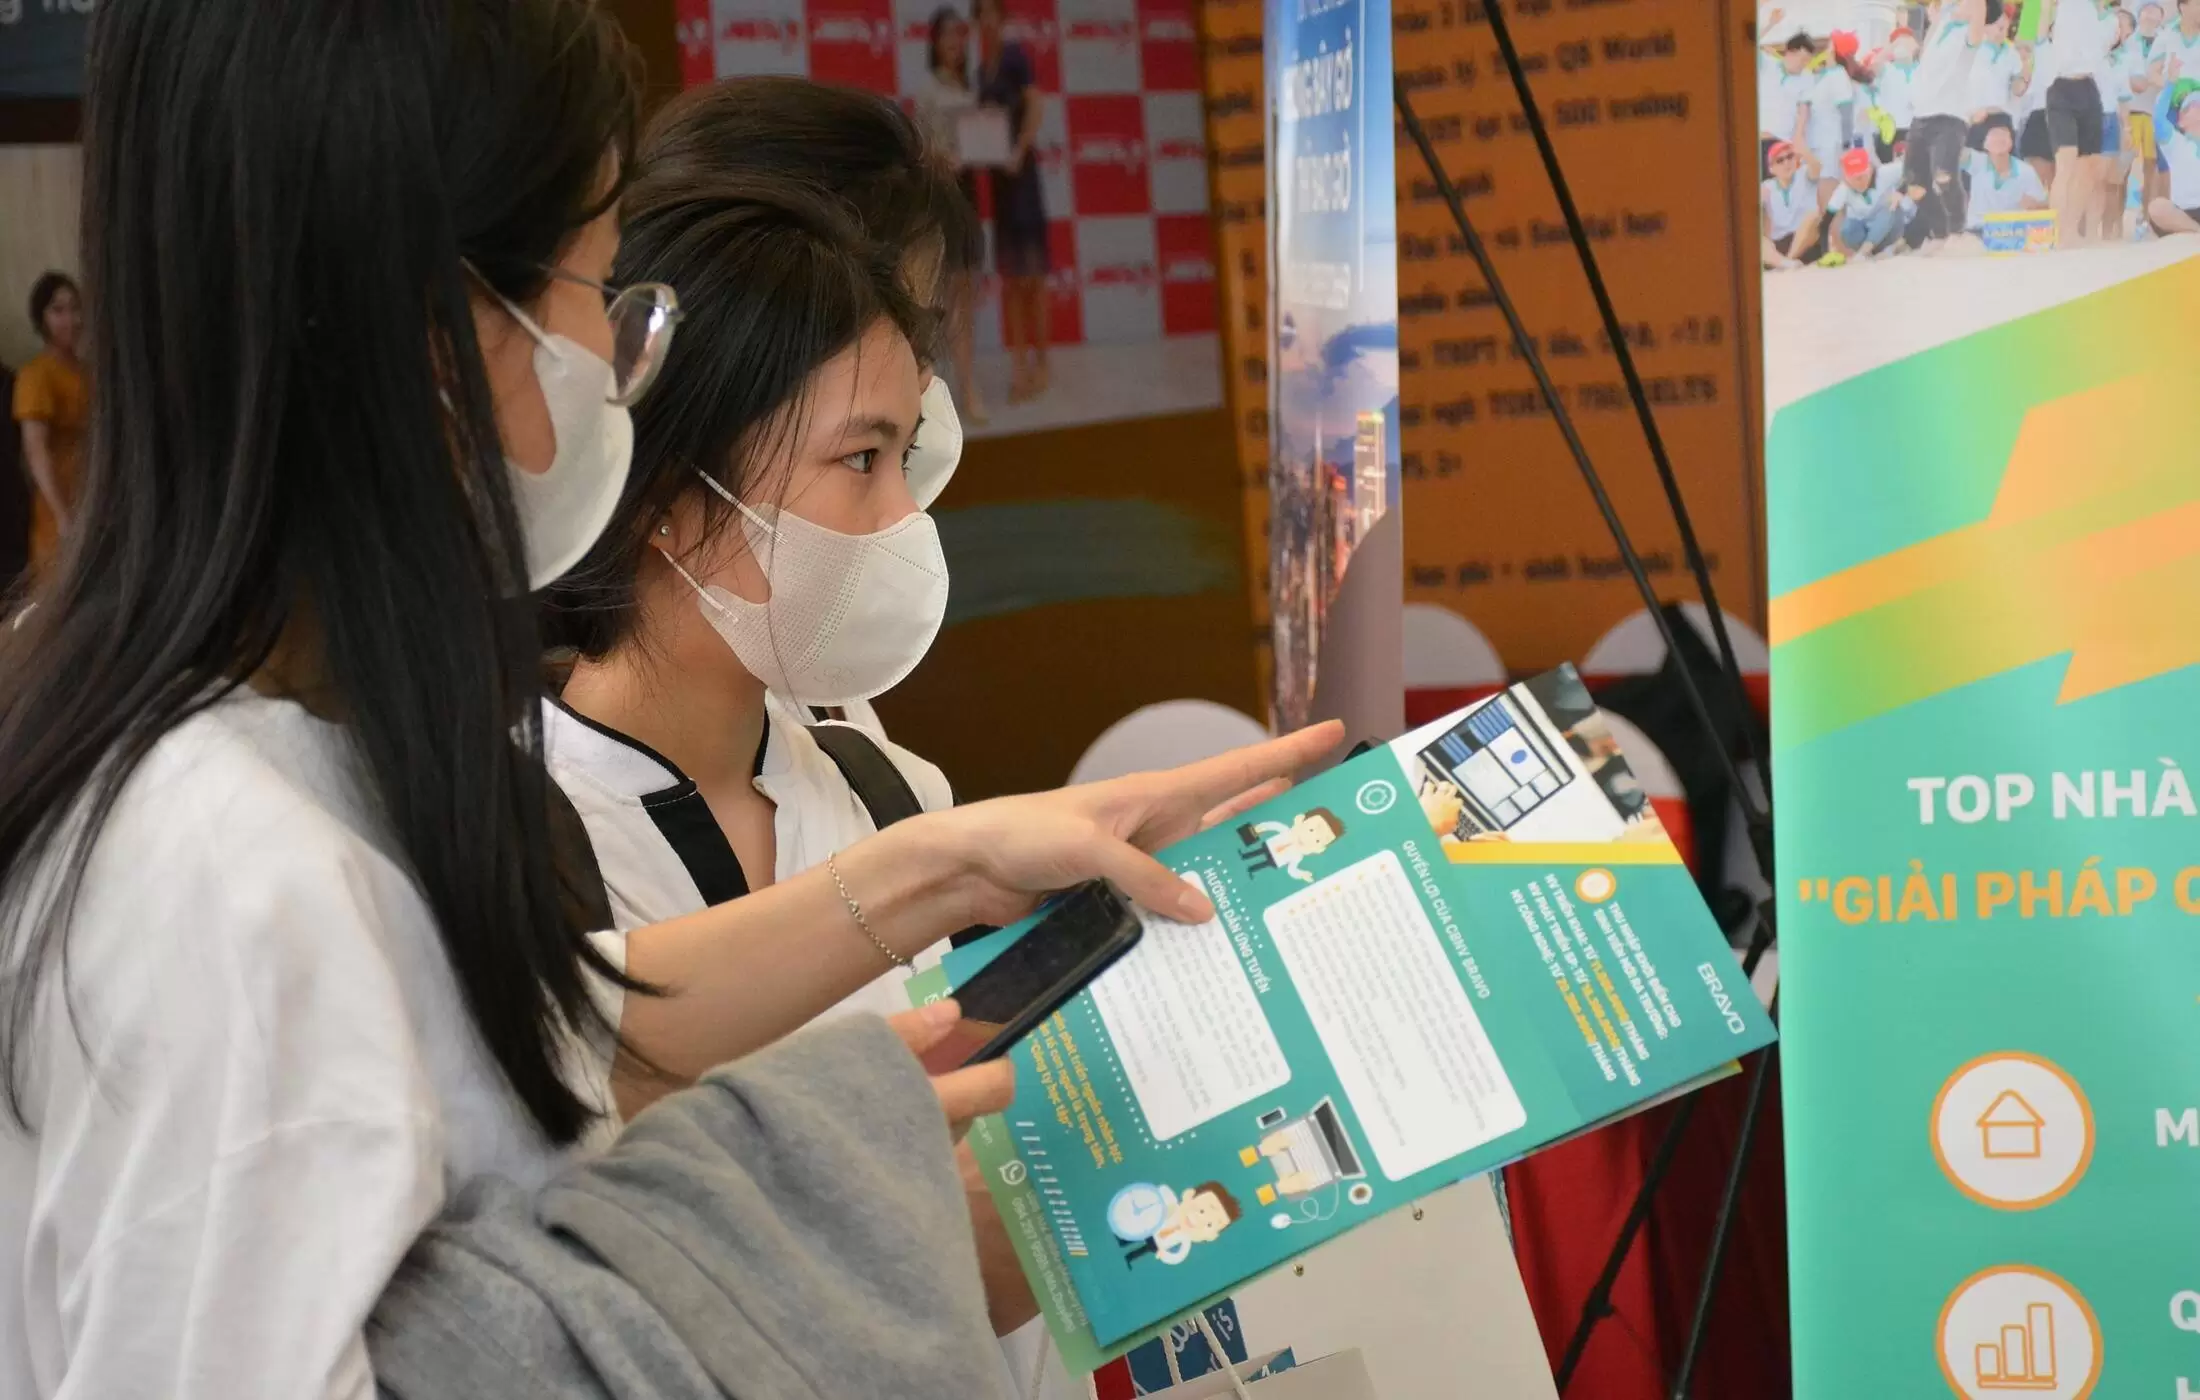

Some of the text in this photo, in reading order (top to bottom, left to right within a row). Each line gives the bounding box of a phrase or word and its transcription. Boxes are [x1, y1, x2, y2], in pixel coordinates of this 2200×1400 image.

[1907, 757, 2198, 825] TOP NHÀ
[1799, 858, 1958, 925] "GIẢI
[1976, 856, 2157, 920] PHÁP
[1460, 956, 1492, 1001] BRAVO
[1696, 959, 1746, 1037] BRAVO
